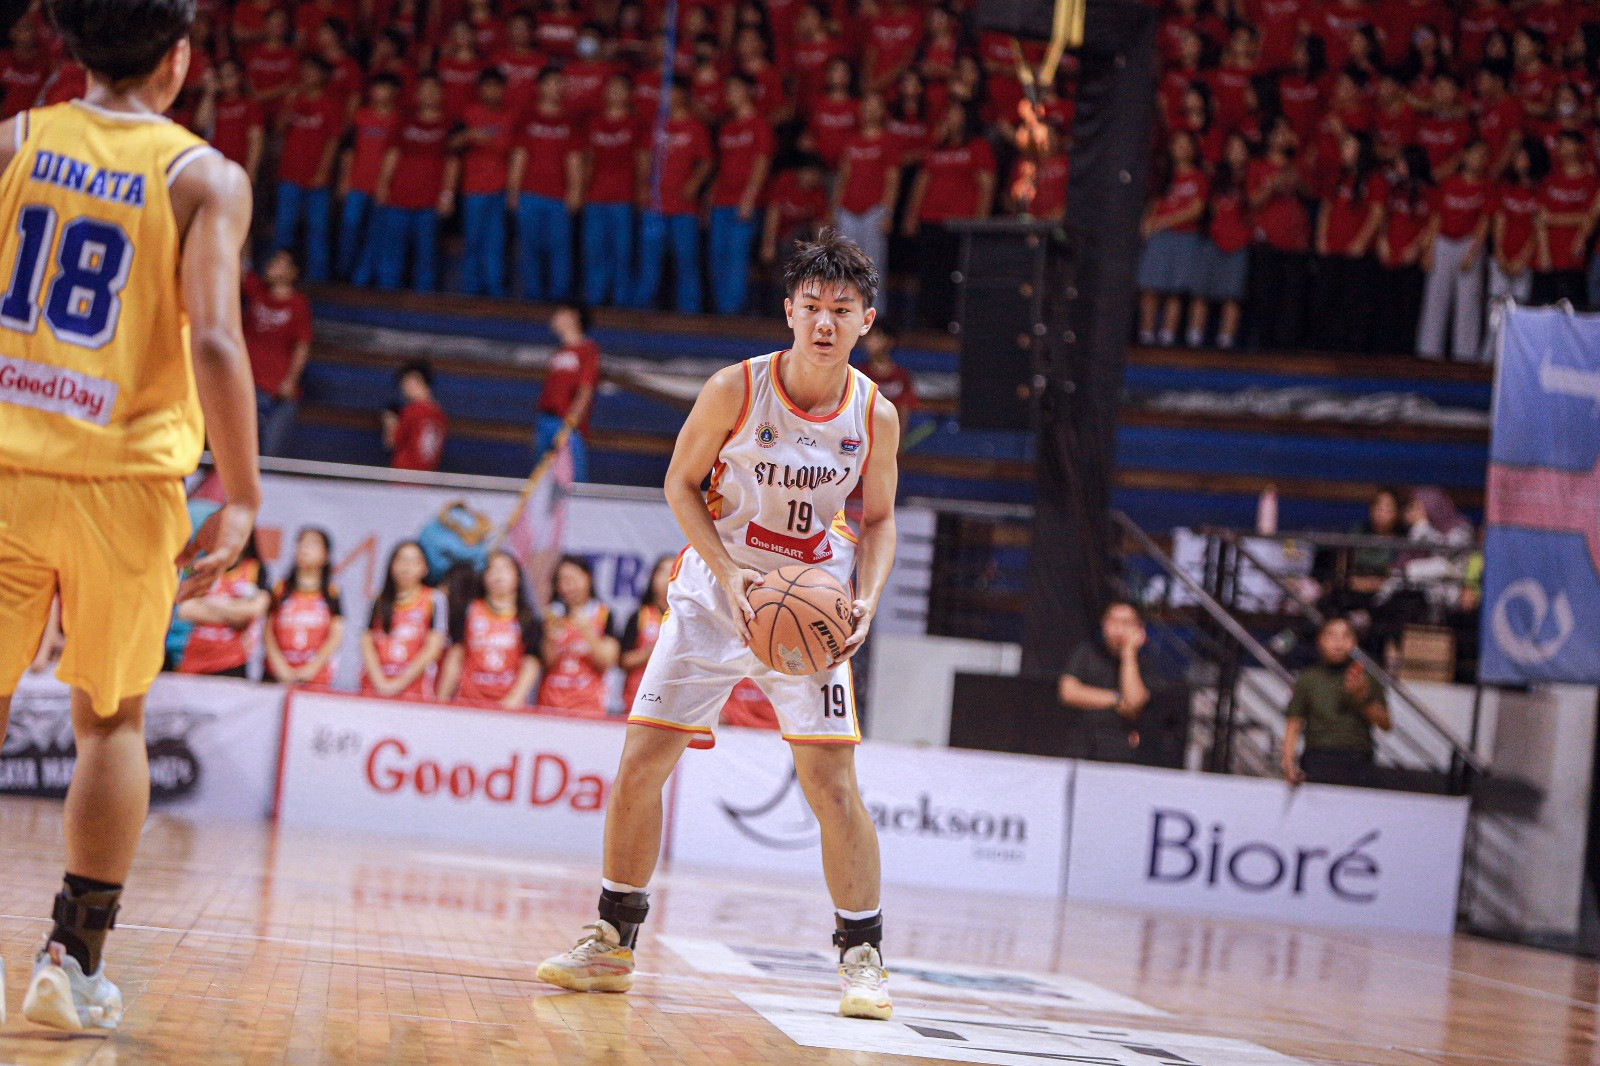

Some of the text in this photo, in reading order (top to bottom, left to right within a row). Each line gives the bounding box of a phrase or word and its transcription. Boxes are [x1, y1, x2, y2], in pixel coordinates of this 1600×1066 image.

[30, 150, 145, 209] DINATA
[0, 203, 135, 350] 18
[0, 364, 105, 418] GoodDay
[750, 536, 770, 549] One
[787, 499, 813, 534] 19
[820, 684, 847, 719] 19
[364, 738, 605, 813] GoodDa
[861, 789, 1028, 843] ackson
[1146, 807, 1383, 904] Bioré
